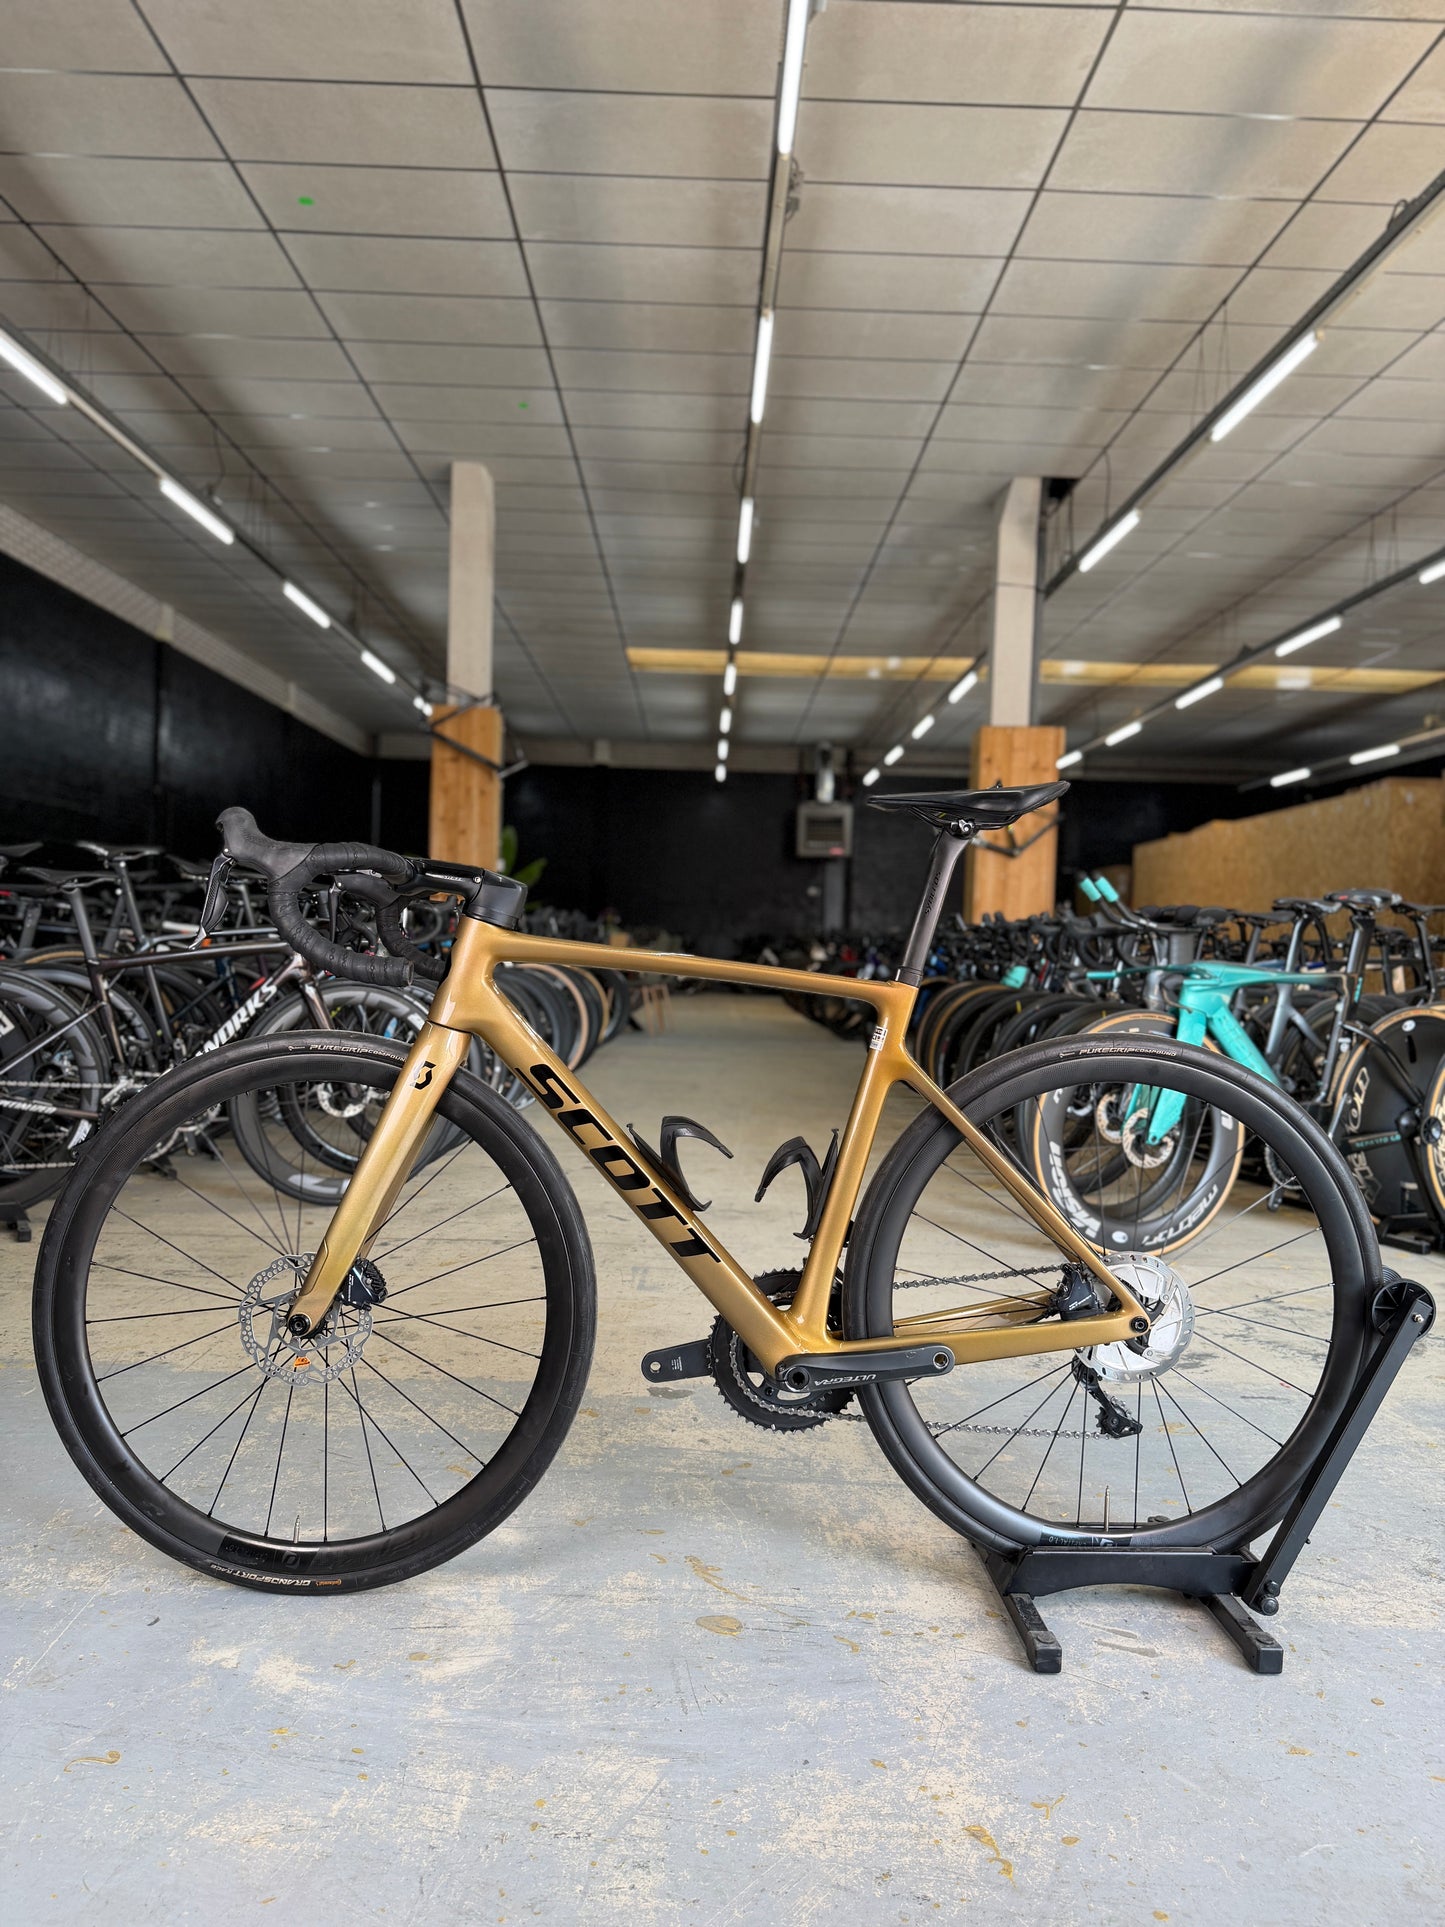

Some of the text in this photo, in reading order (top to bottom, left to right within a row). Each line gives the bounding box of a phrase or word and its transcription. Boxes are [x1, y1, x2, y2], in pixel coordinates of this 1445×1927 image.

[309, 1043, 368, 1054] PUREGRIP
[367, 1048, 407, 1062] COMPOUN
[1079, 1046, 1135, 1056] PUREGRIP
[514, 1063, 721, 1264] SCOTT
[814, 1374, 877, 1386] ULTEGRA
[232, 1570, 311, 1586] GRANDSPORT
